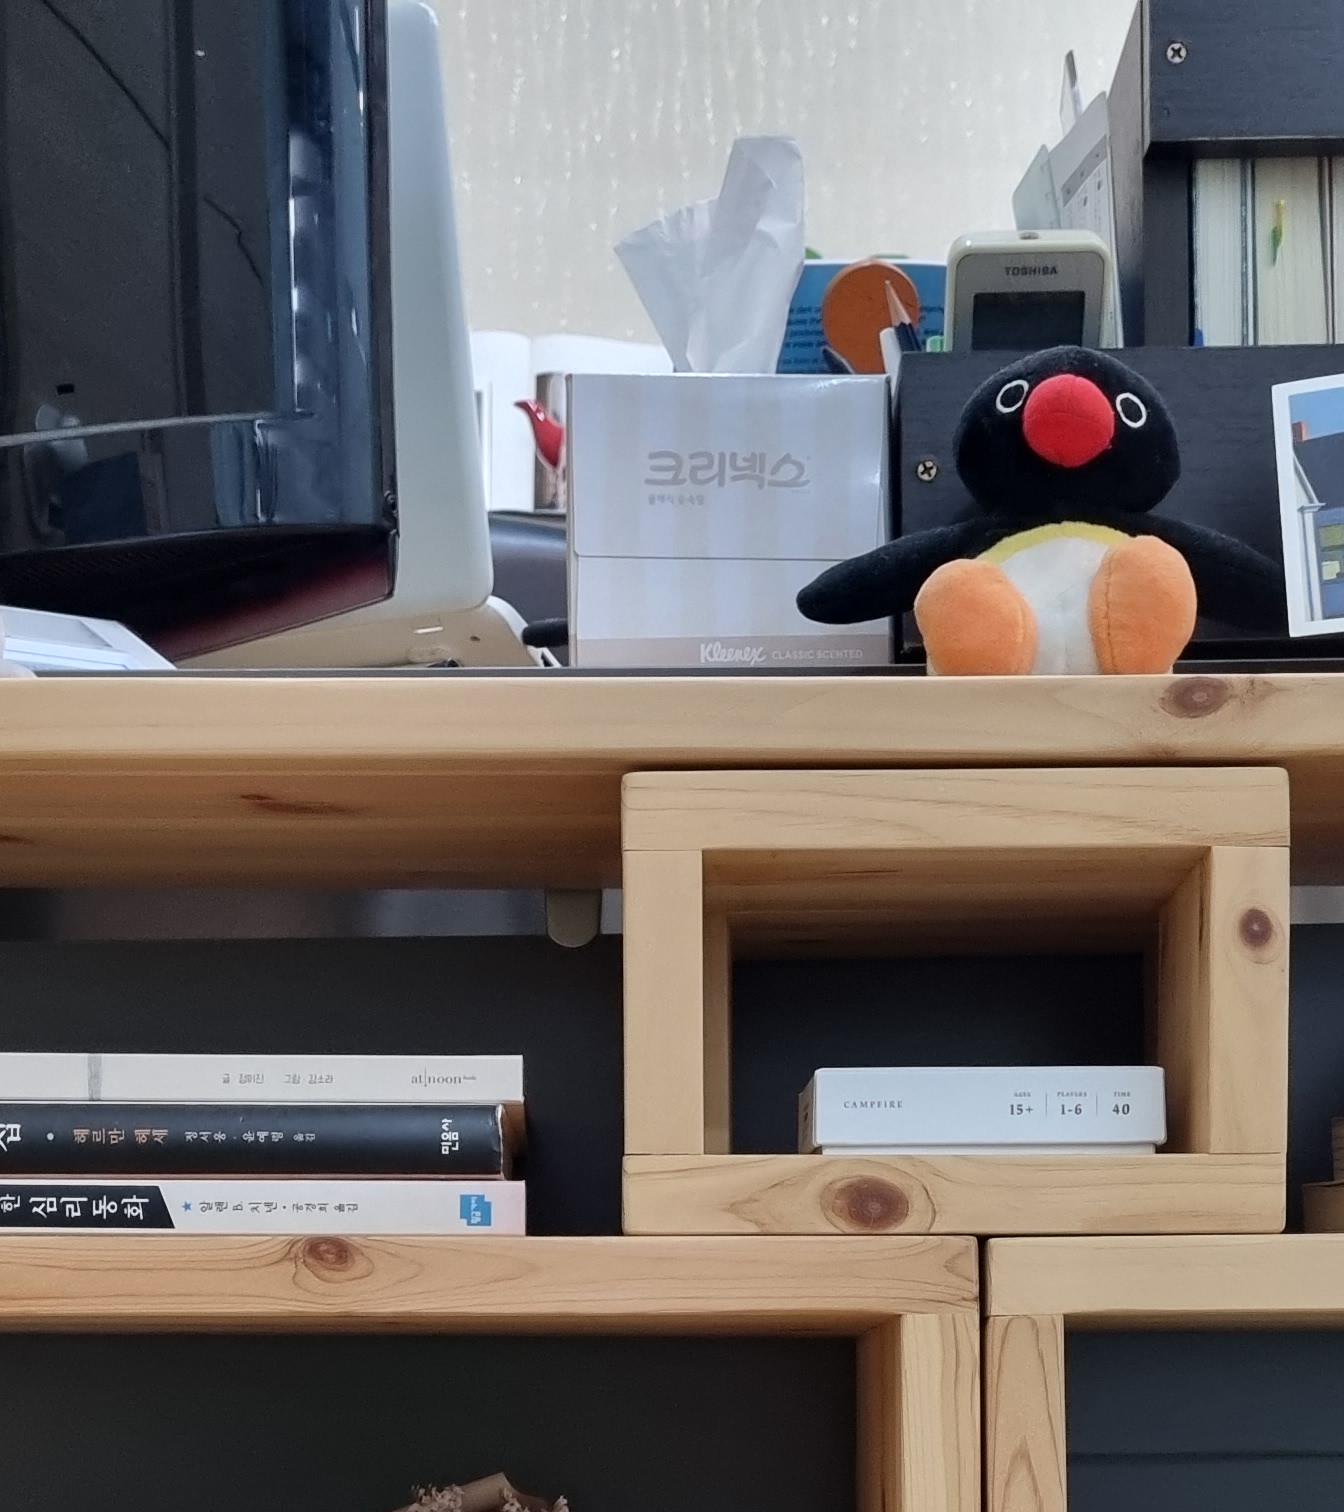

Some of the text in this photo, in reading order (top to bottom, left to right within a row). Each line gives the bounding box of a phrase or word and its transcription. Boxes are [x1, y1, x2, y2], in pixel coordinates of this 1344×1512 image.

[1005, 265, 1058, 276] TOSHIBA
[644, 450, 811, 490] 크리넥스
[699, 642, 815, 666] Kleenex CLASSIC
[843, 1099, 904, 1109] CAMPFIRE
[1009, 1103, 1034, 1116] 15+
[1060, 1103, 1082, 1116] 1-6
[1112, 1103, 1131, 1116] 40
[440, 1118, 459, 1155] 민음사
[29, 1195, 150, 1222] 심리동화
